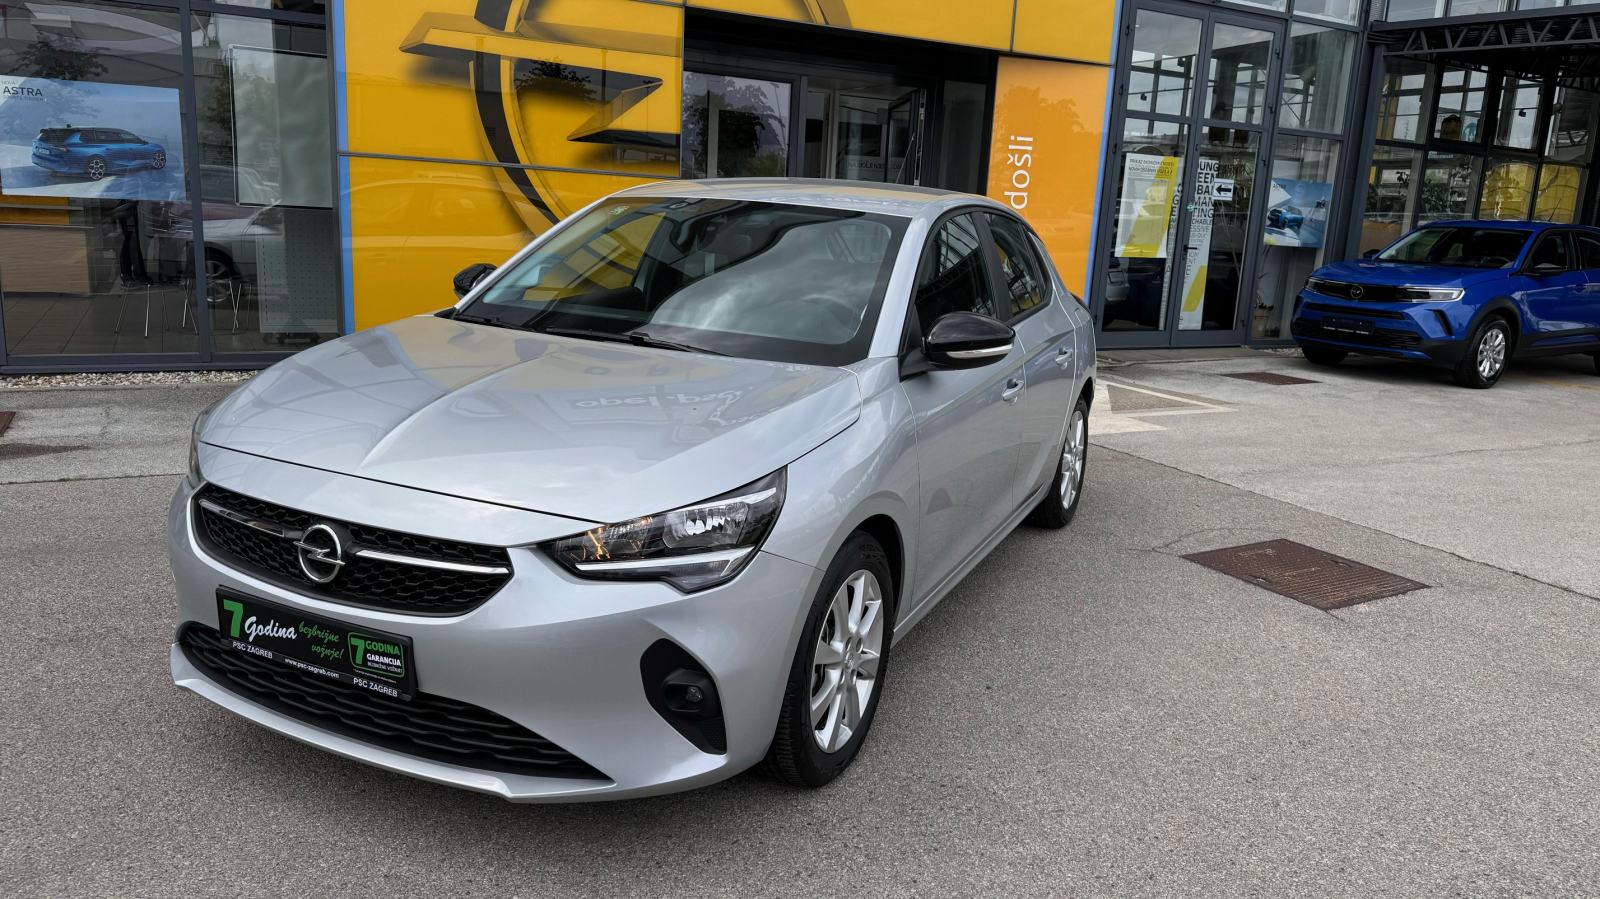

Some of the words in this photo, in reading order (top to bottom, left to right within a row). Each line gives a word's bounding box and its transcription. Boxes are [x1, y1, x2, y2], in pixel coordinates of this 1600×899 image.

[3, 86, 42, 96] ASTRA
[1003, 135, 1034, 210] došli
[223, 599, 244, 638] 7
[244, 615, 297, 643] Godina
[298, 621, 340, 642] bezbrižne
[232, 641, 246, 651] PSC
[247, 643, 273, 659] ZAGREB
[351, 637, 365, 665] 7
[365, 640, 401, 655] GODINA
[284, 658, 340, 679] www.psc-zagreb.com
[353, 677, 368, 689] PSC
[369, 682, 398, 698] ZAGREB
